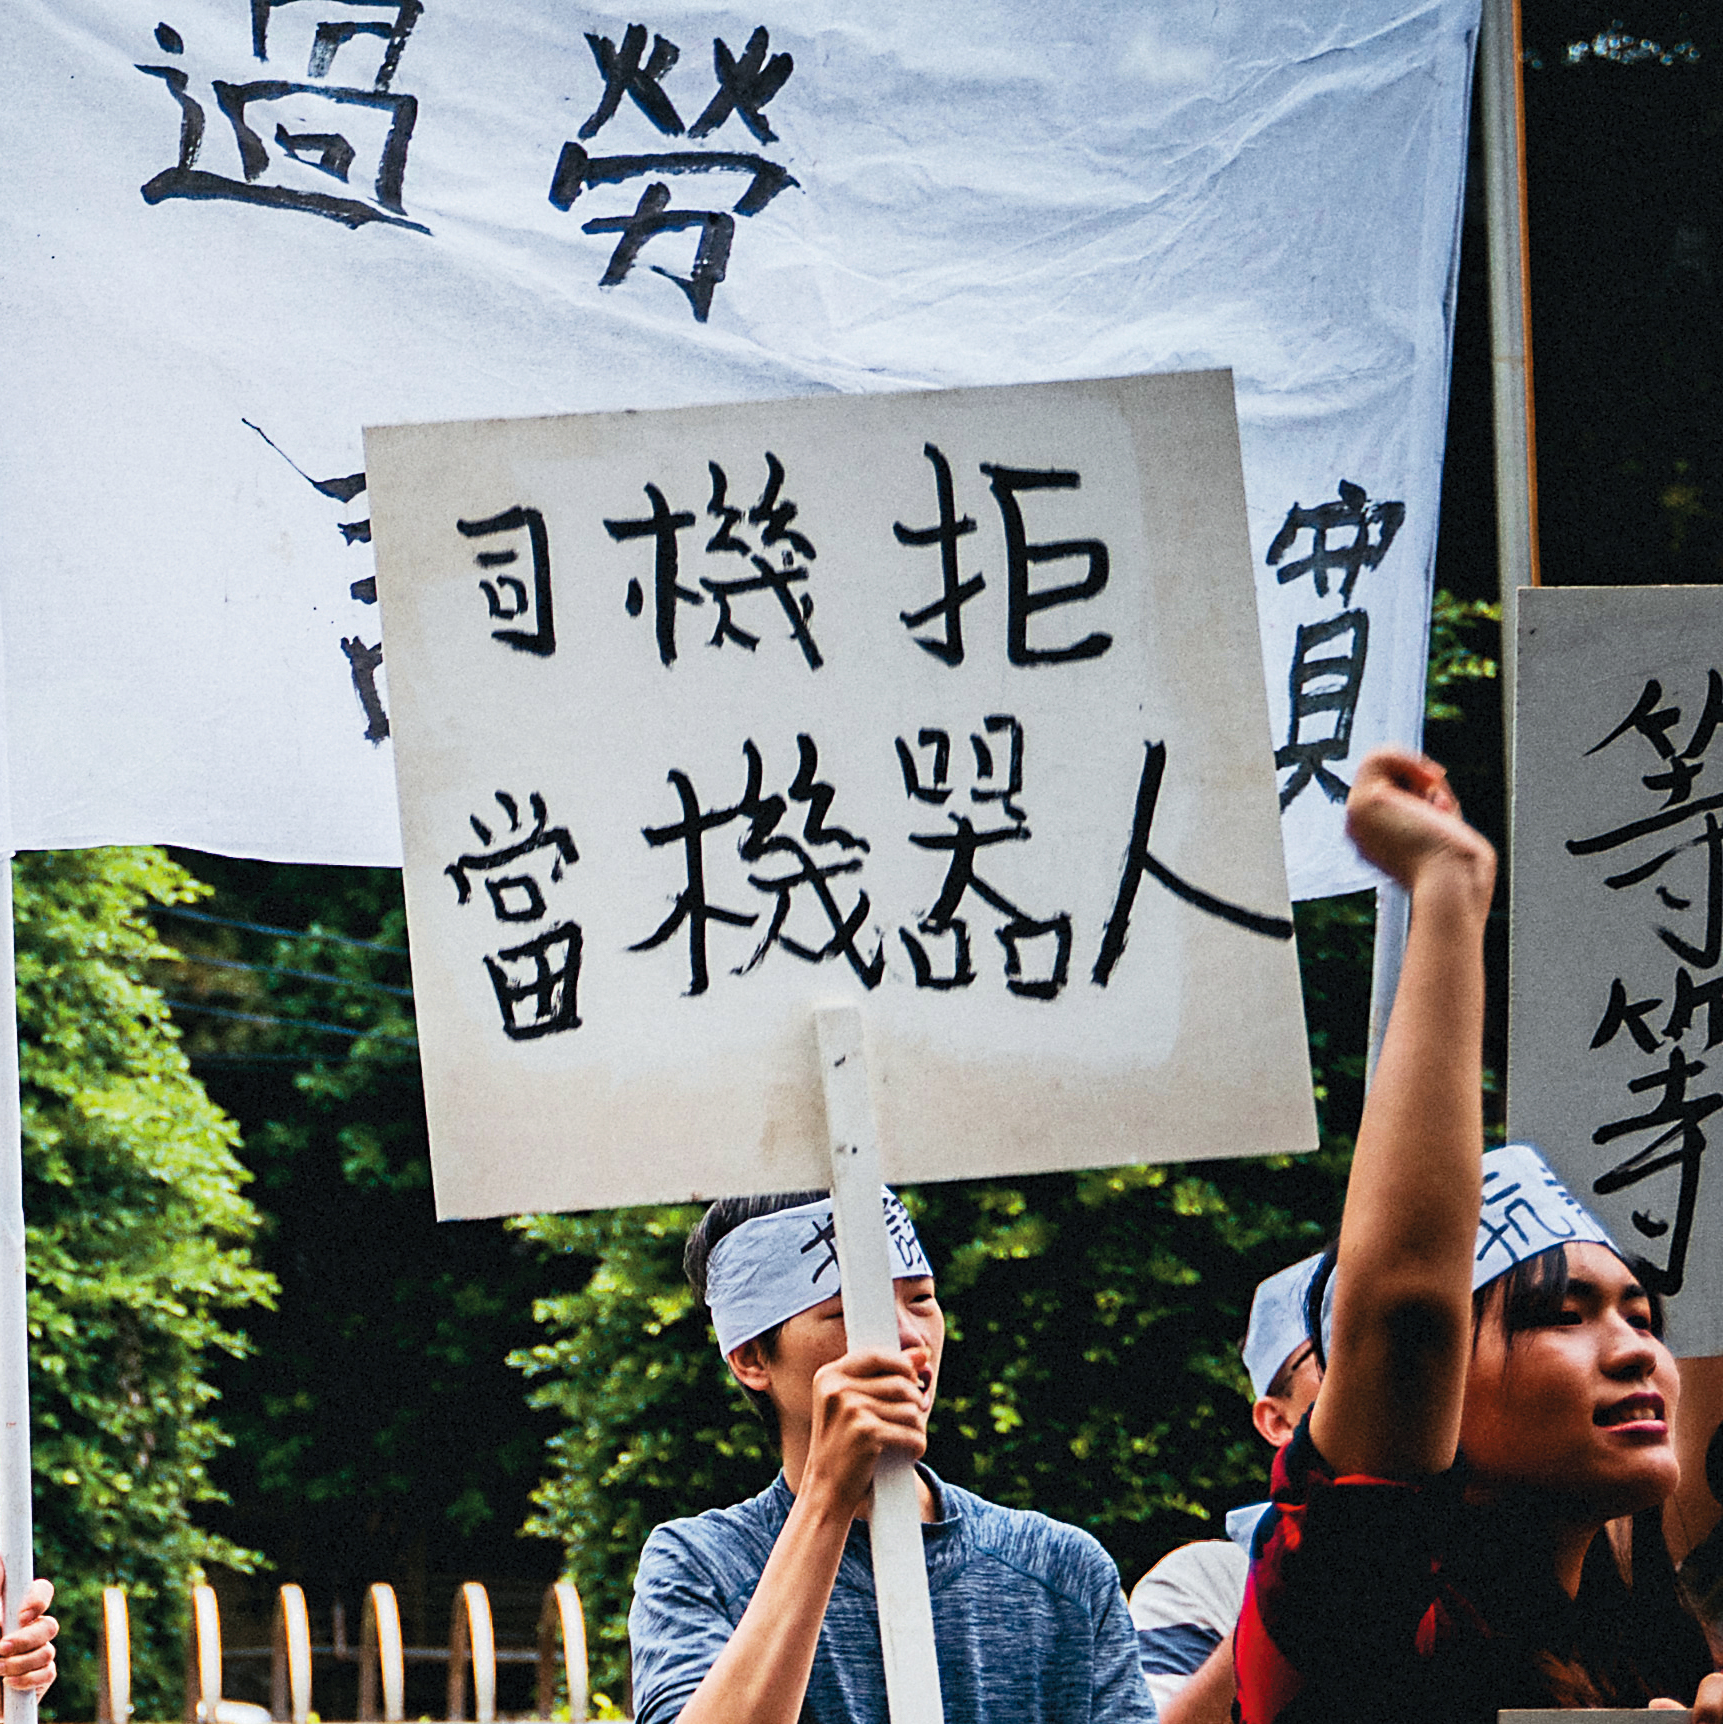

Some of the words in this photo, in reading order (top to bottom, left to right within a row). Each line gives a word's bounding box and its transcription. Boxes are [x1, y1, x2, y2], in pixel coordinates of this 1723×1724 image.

[139, 0, 804, 322] 過勞
[457, 442, 1117, 670] 司機拒
[443, 713, 1294, 1041] 當機器人
